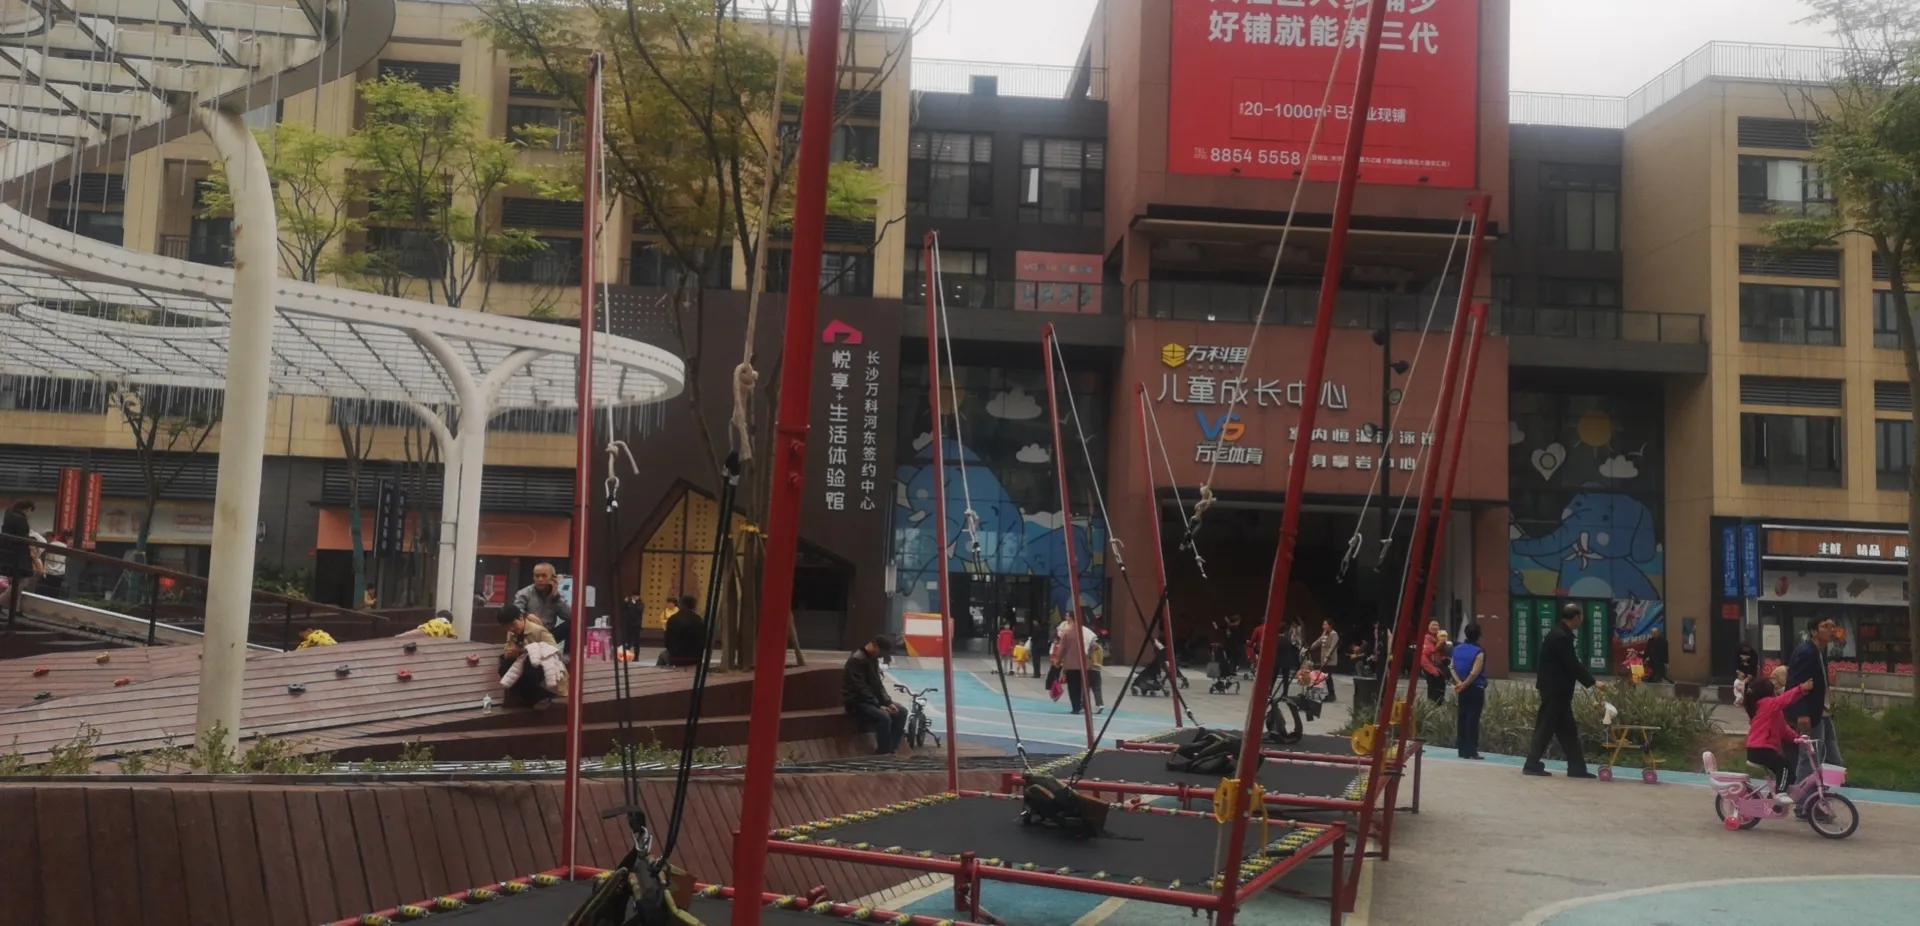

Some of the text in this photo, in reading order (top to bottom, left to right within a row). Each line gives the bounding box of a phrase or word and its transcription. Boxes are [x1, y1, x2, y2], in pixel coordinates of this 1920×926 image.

[1208, 10, 1439, 54] 好铺就能养三代
[1210, 147, 1252, 163] 8854
[1258, 149, 1301, 166] 5558
[1186, 345, 1249, 364] 万科里
[1157, 373, 1348, 410] 儿童成长中心
[859, 350, 881, 511] 长沙万科河东签约中心
[1195, 444, 1263, 465] 万运体育
